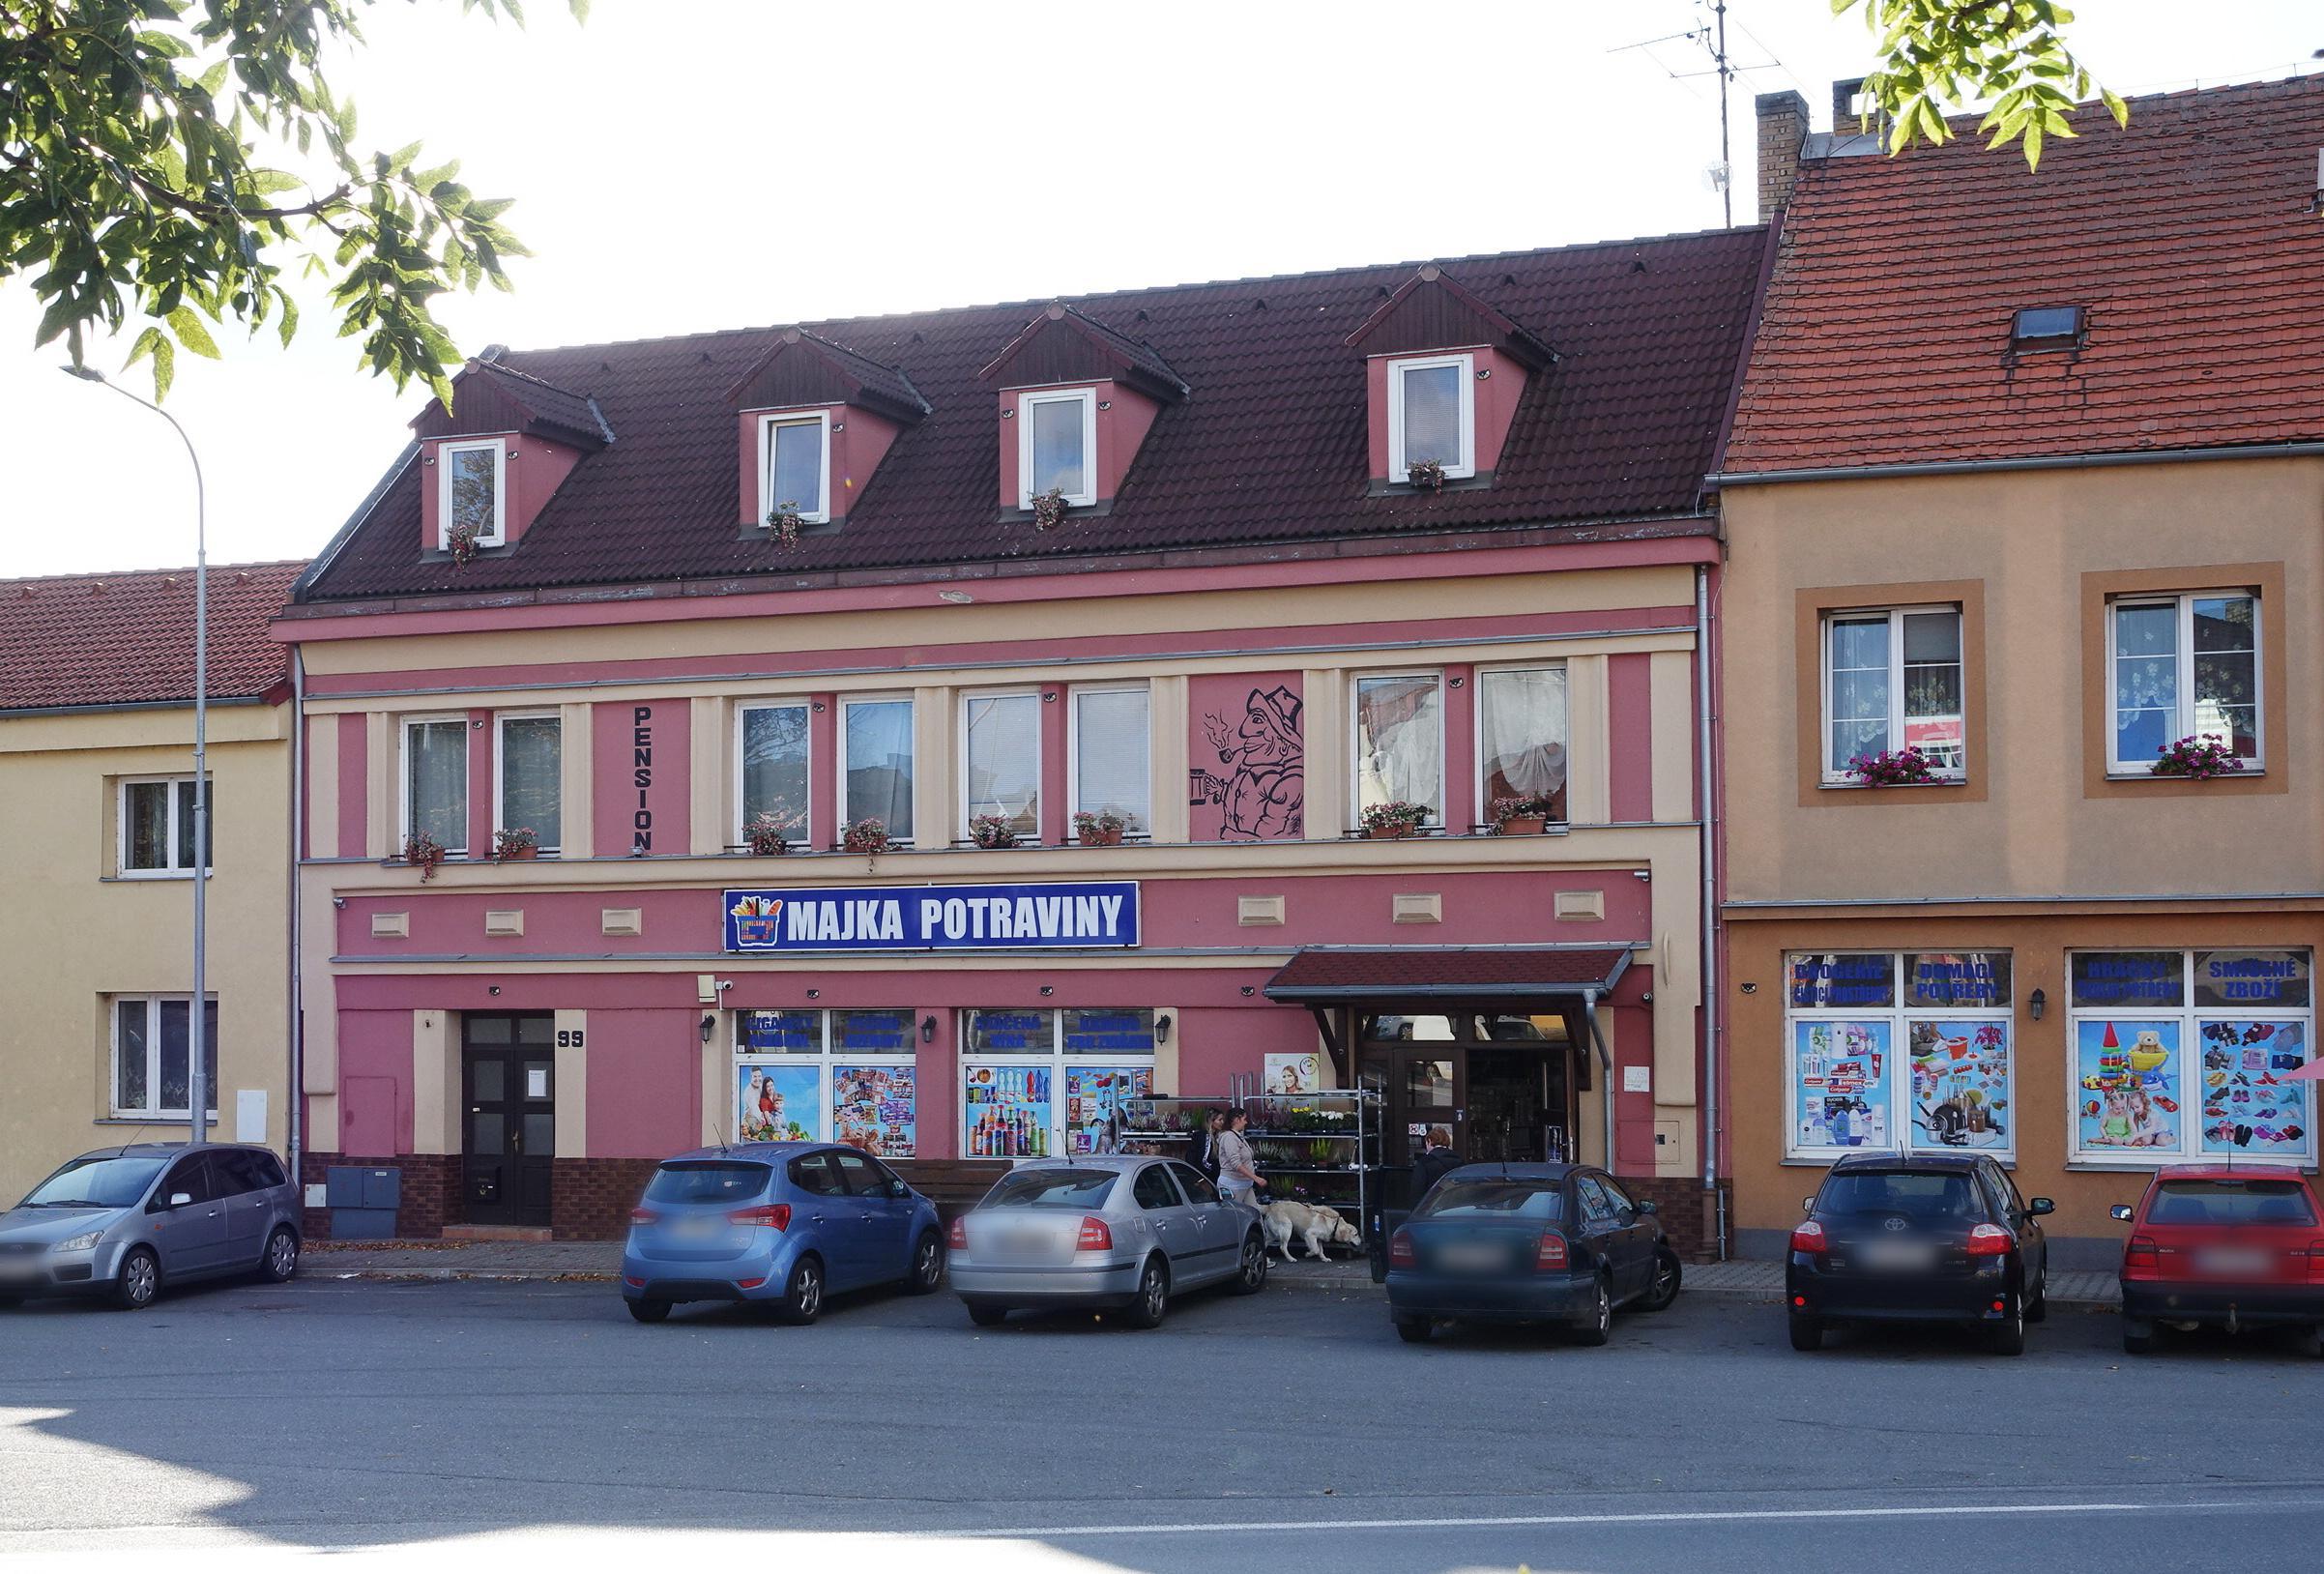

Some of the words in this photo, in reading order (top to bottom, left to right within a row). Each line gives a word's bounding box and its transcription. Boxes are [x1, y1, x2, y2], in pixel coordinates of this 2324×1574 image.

[634, 707, 653, 851] PENSION
[787, 898, 905, 942] MAJKA
[920, 894, 1123, 940] POTRAVINY
[557, 1030, 584, 1048] 99
